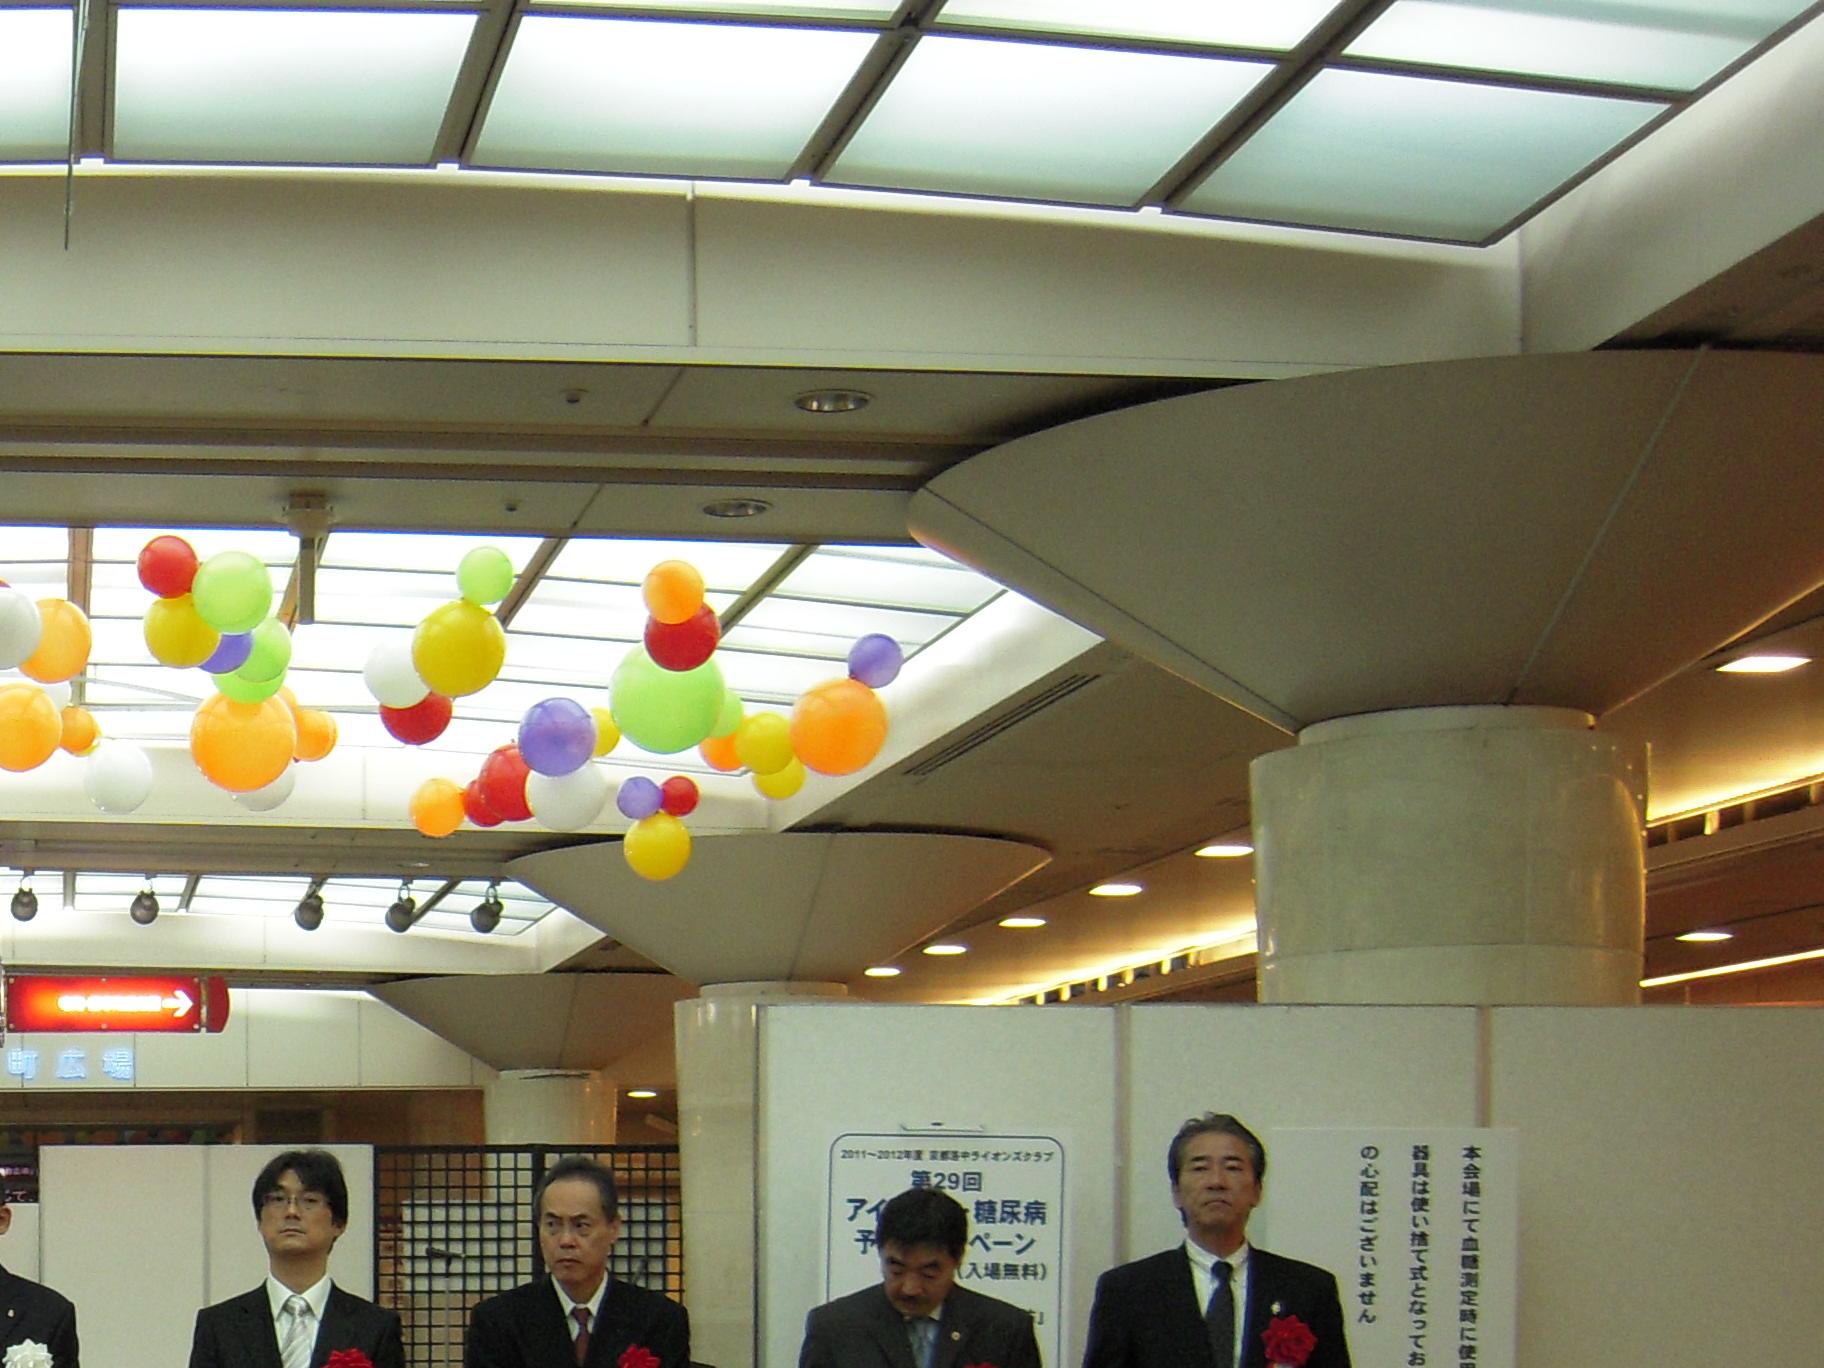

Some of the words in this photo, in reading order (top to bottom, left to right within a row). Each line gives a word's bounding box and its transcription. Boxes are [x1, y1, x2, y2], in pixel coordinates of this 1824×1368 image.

[911, 1170, 983, 1193] 第29回
[956, 1263, 1048, 1281] (入場無料)
